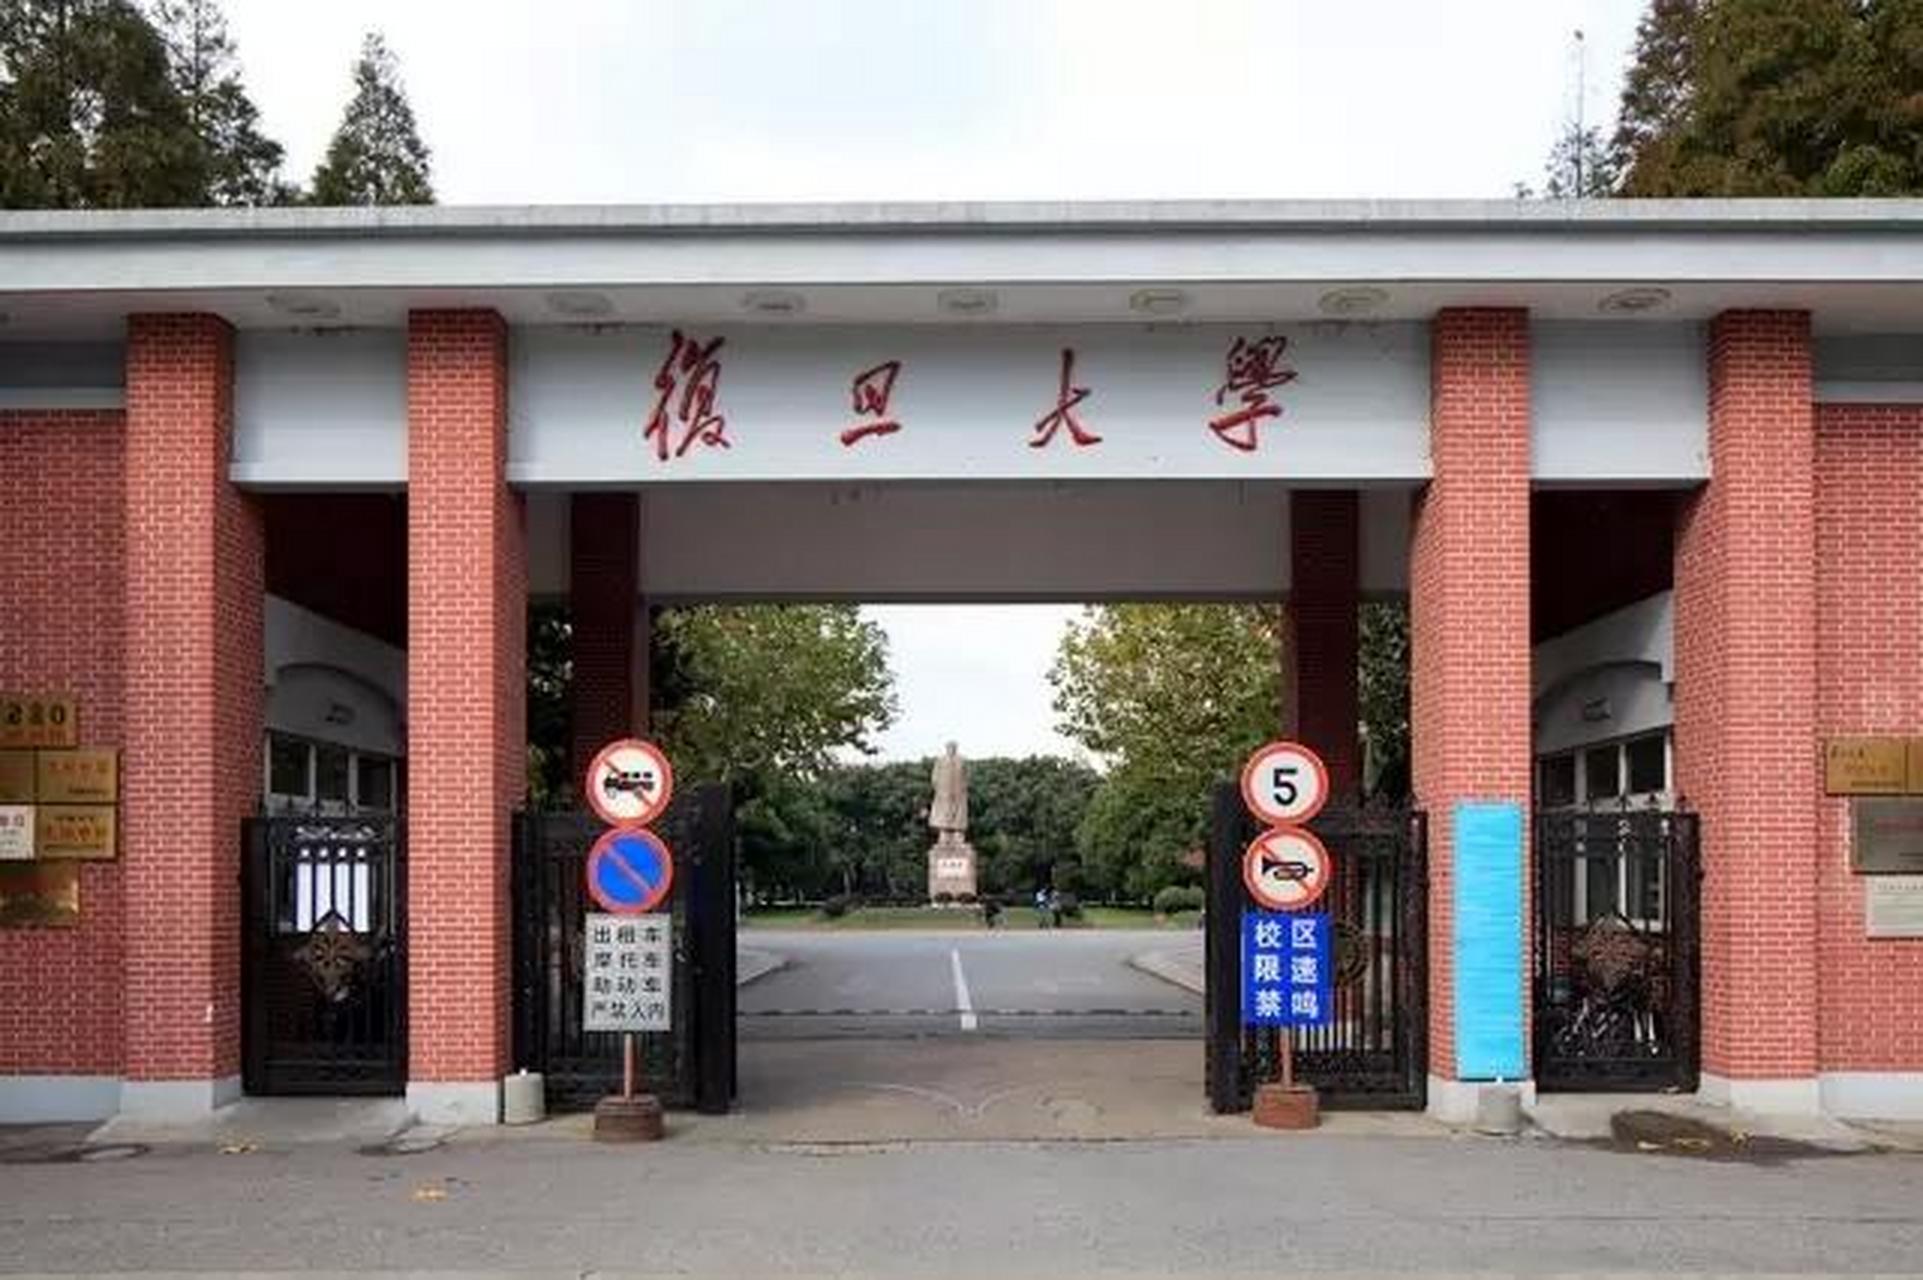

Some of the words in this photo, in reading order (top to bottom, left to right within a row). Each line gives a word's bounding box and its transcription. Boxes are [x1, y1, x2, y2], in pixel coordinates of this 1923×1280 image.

[1272, 767, 1299, 806] 5
[594, 926, 662, 944] 出租车
[1255, 919, 1318, 948] 校区
[594, 951, 662, 968] 摩托车
[1254, 954, 1319, 983] 限速
[591, 1001, 665, 1020] 严禁入内
[1255, 989, 1319, 1018] 禁鸣
